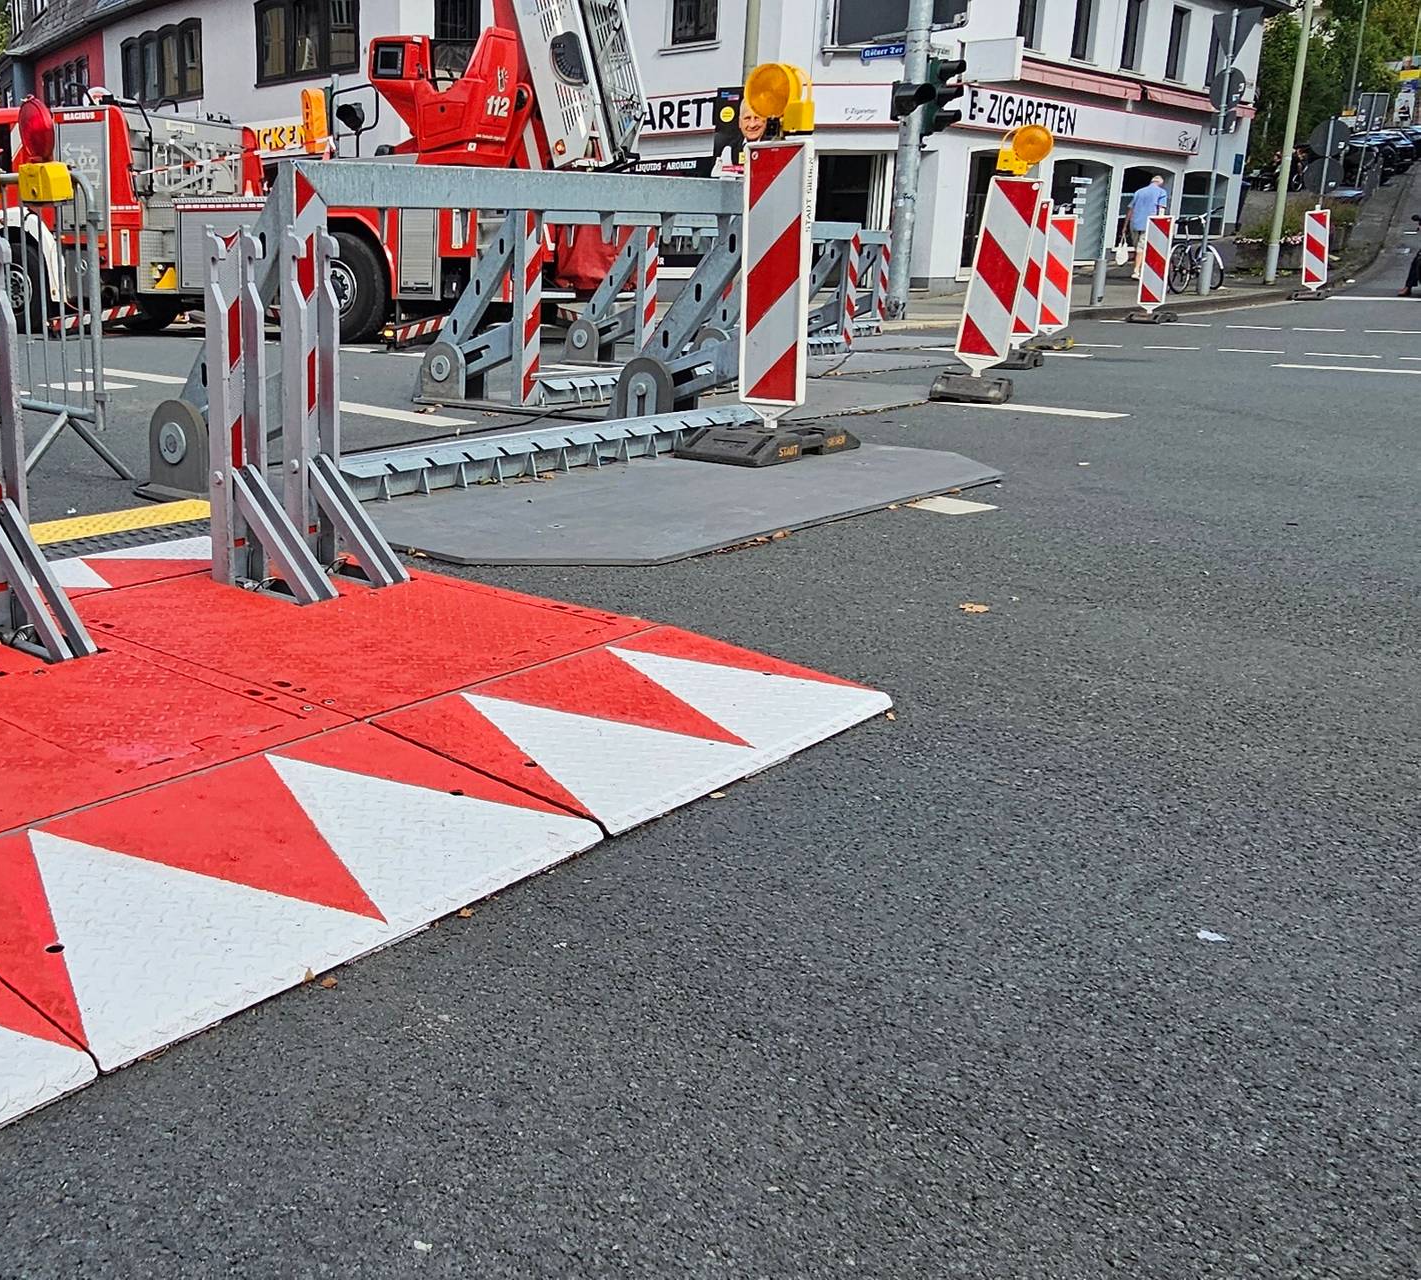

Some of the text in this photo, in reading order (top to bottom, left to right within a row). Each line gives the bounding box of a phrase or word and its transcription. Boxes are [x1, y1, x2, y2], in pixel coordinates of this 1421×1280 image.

[487, 95, 510, 117] 112
[63, 112, 96, 120] MAGIRUS
[666, 160, 697, 170] AROMEN
[778, 444, 799, 458] STADT
